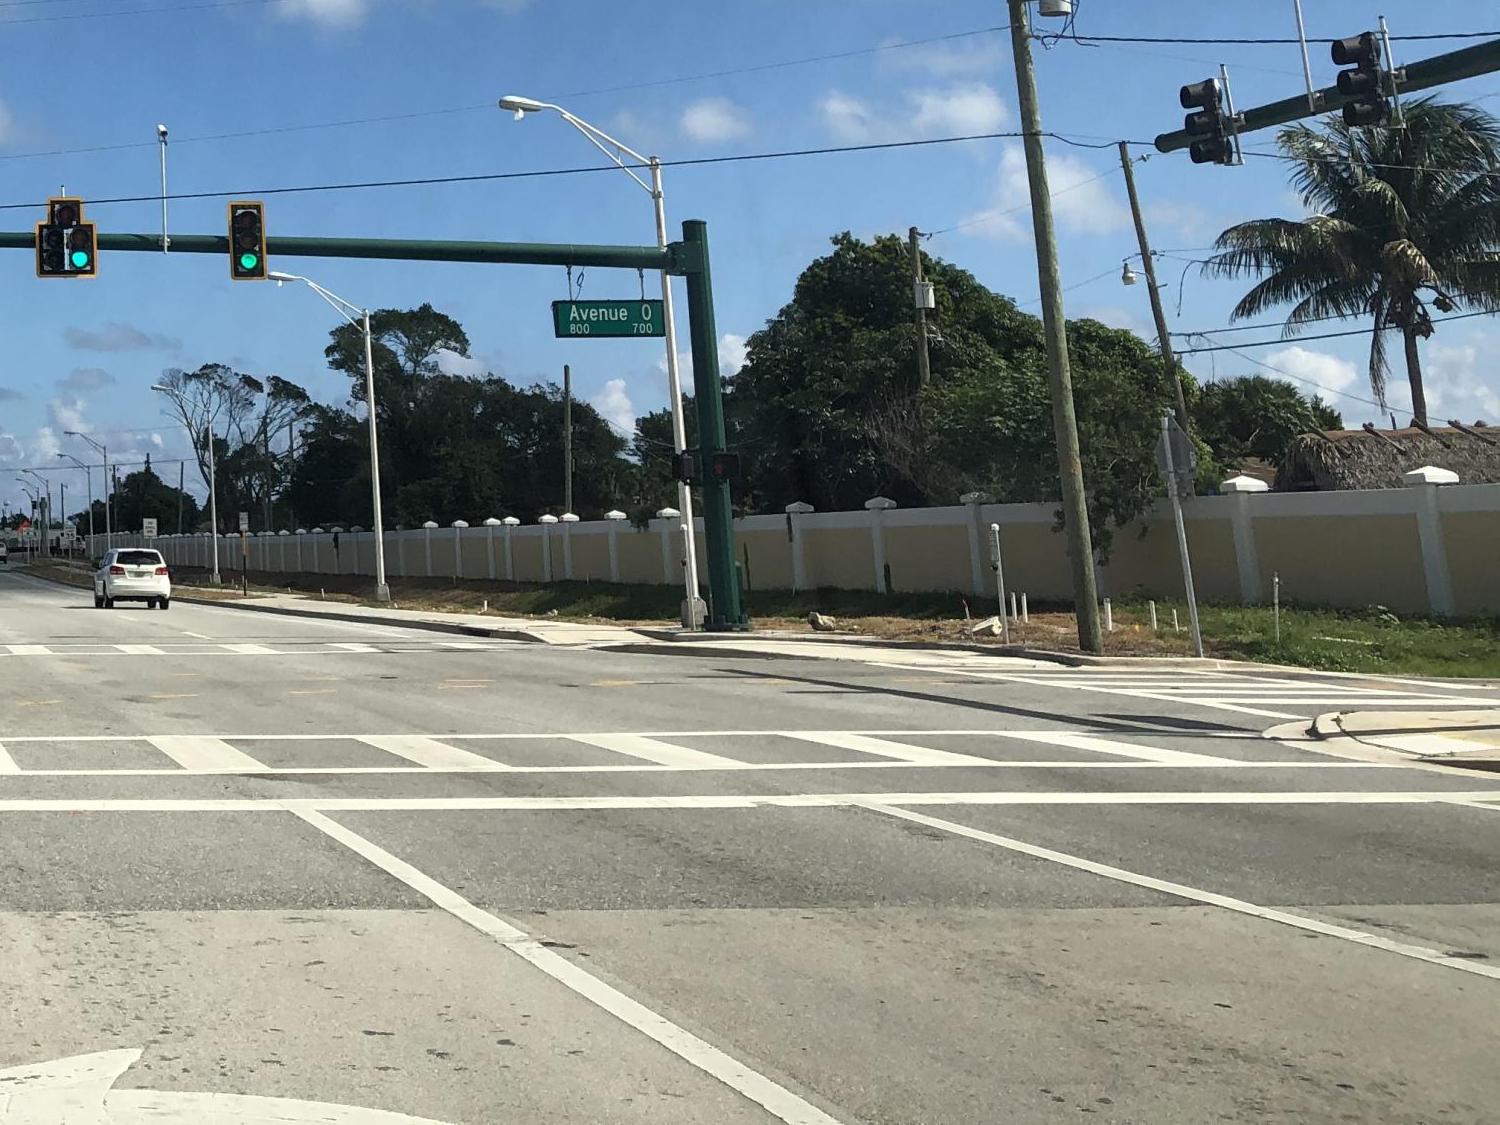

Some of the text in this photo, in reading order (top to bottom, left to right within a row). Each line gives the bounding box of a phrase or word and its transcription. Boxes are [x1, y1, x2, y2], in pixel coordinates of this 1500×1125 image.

[569, 304, 628, 321] Avenue
[569, 323, 653, 334] 800 700
